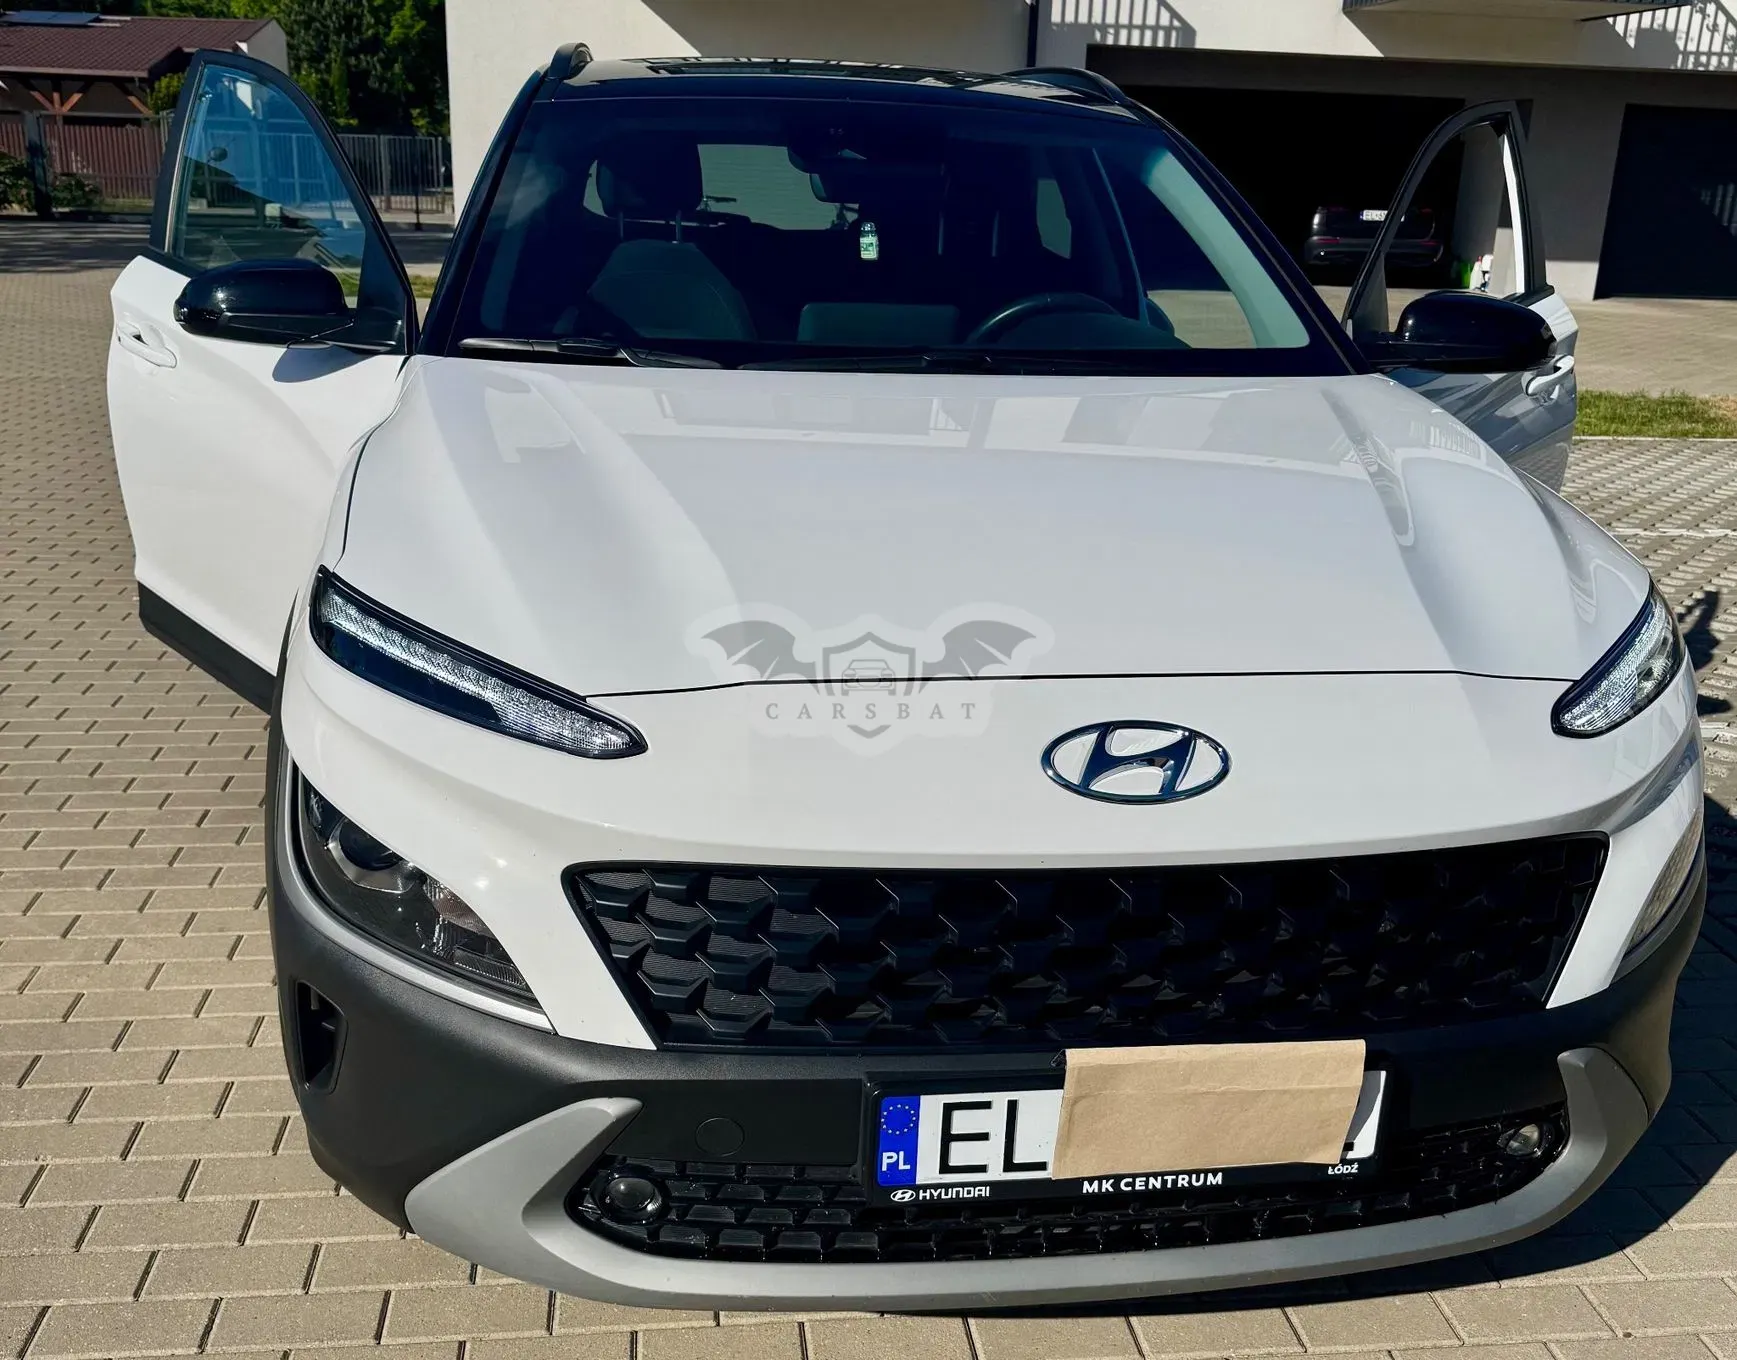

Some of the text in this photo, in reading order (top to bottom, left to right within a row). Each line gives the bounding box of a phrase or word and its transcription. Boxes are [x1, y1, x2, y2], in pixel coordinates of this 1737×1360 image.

[881, 1151, 911, 1172] PL
[1328, 1162, 1359, 1175] ŁÓDŹ
[1082, 1172, 1223, 1194] MK CENTRUM
[919, 1186, 990, 1200] HYUNDAI
